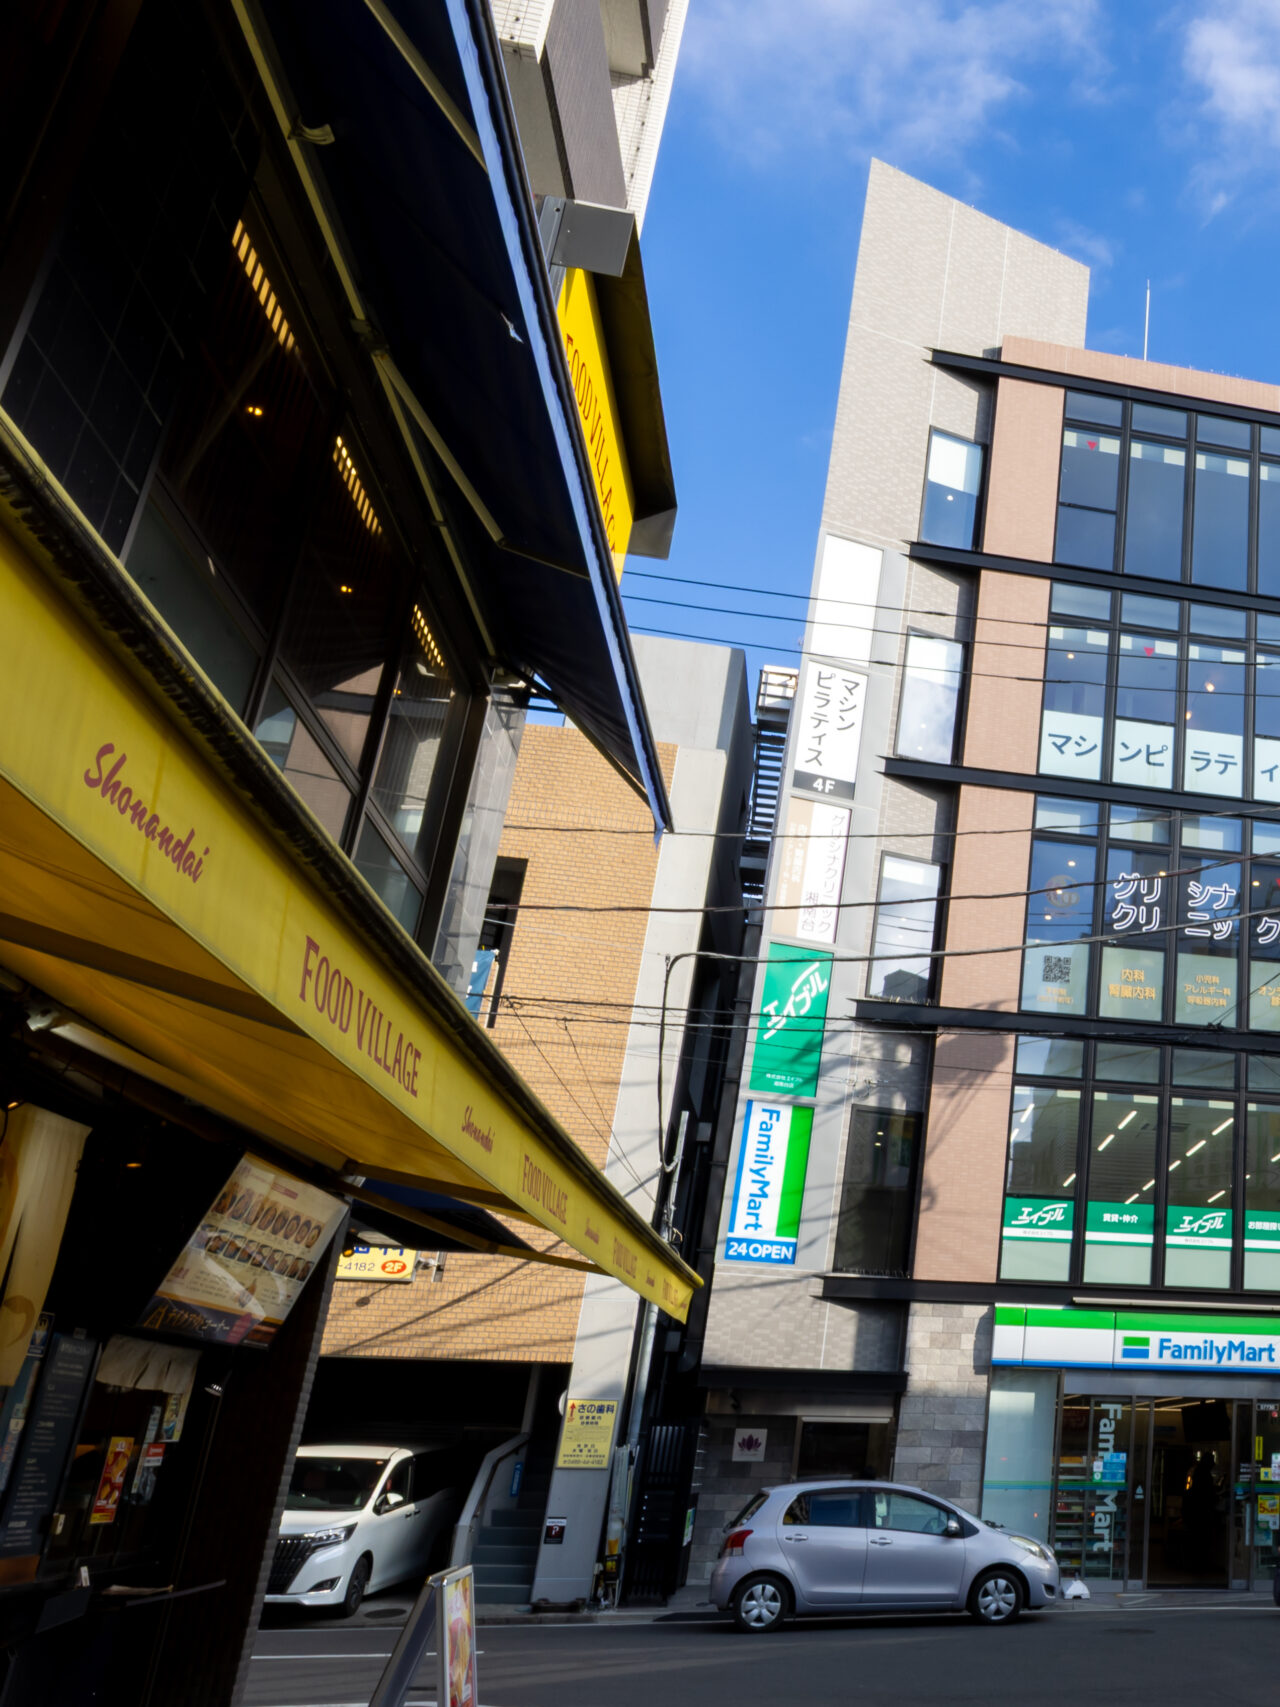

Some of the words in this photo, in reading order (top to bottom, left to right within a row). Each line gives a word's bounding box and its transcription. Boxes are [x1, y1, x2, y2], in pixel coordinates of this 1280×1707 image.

[588, 394, 616, 563] VILLAG
[804, 670, 836, 768] ピラティス
[836, 677, 861, 733] マシン
[812, 777, 836, 794] 4F
[84, 741, 211, 885] Shonandai
[1121, 968, 1145, 982] 内科
[298, 934, 353, 1035] FOOD
[355, 988, 423, 1098] VILLAGE
[763, 962, 828, 1041] エイブル
[521, 1153, 542, 1202] FOOD
[541, 1170, 569, 1225] VILLAGE
[743, 1107, 781, 1232] FamilyMart
[1011, 1203, 1068, 1226] エイブル
[1173, 1212, 1227, 1234] エイブル
[384, 1263, 405, 1273] 2F
[727, 1241, 748, 1257] 24
[748, 1242, 793, 1260] OPEN
[1159, 1337, 1276, 1364] FamilyMart
[578, 1403, 615, 1414] さの歯科
